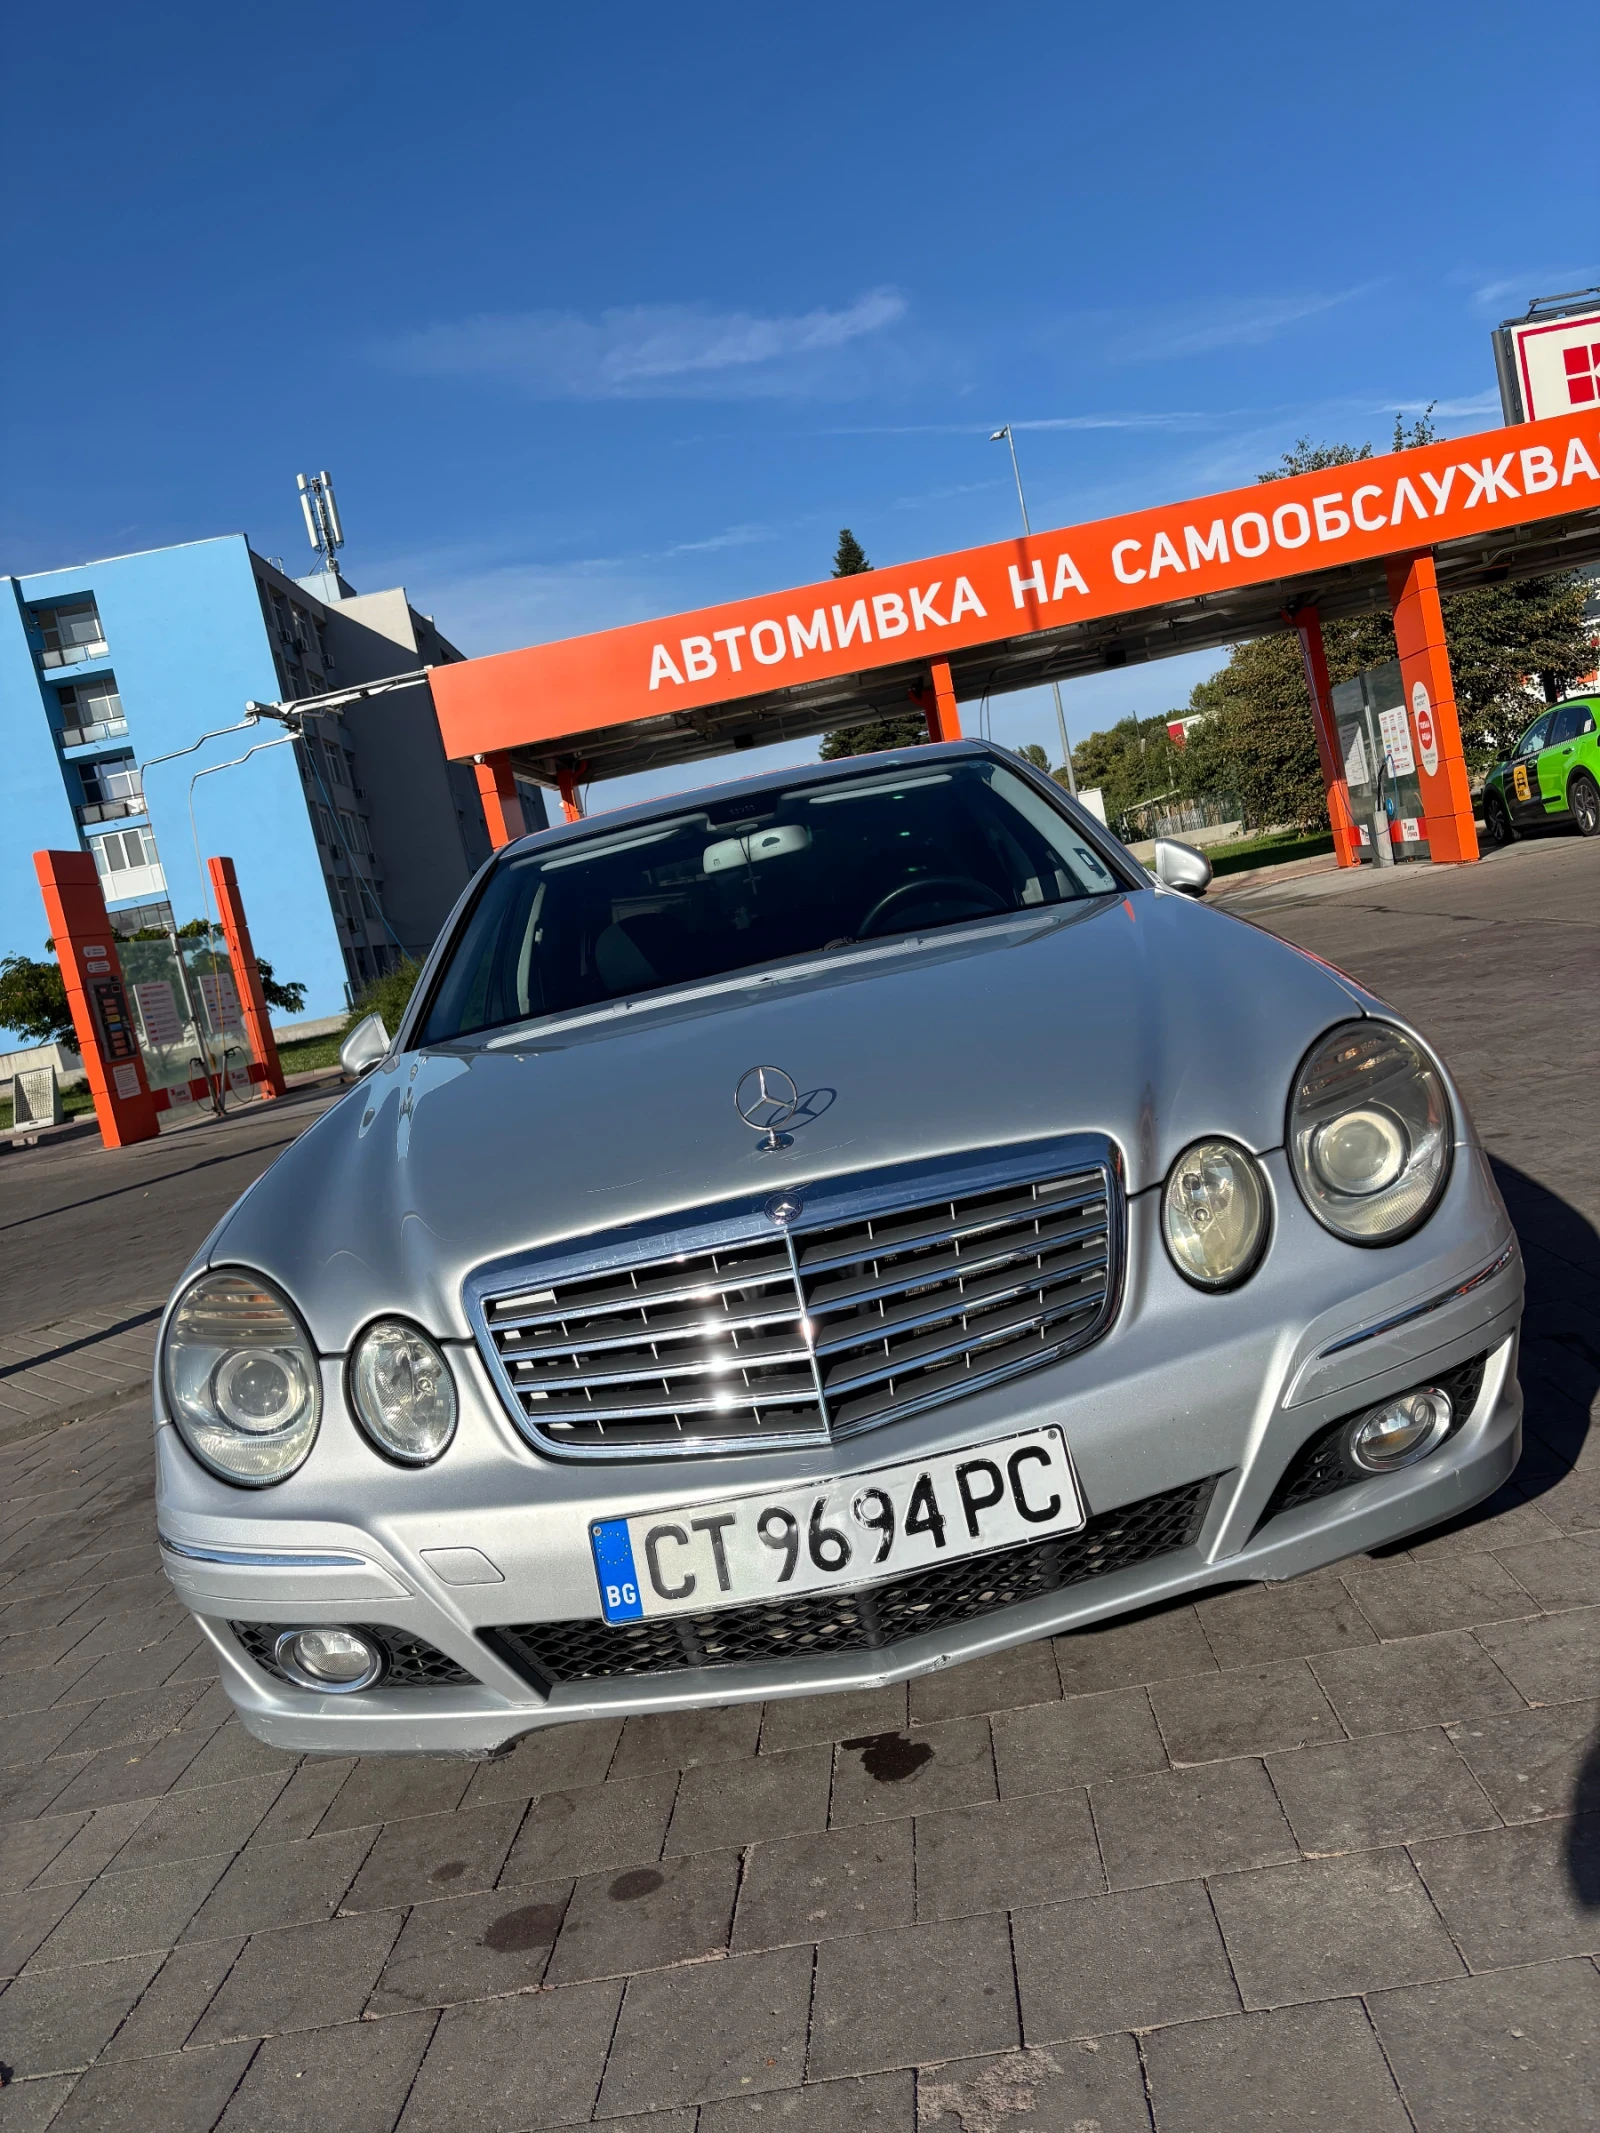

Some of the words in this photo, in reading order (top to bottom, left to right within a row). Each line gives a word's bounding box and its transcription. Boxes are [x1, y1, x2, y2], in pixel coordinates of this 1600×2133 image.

[648, 576, 988, 691] АВТОМИВКА
[1007, 553, 1090, 610] НА
[1111, 433, 1600, 585] САМООБСЛУЖВА
[606, 1583, 637, 1608] BG
[645, 1512, 736, 1600] CT
[757, 1471, 947, 1584] 9694
[954, 1445, 1063, 1538] PC
